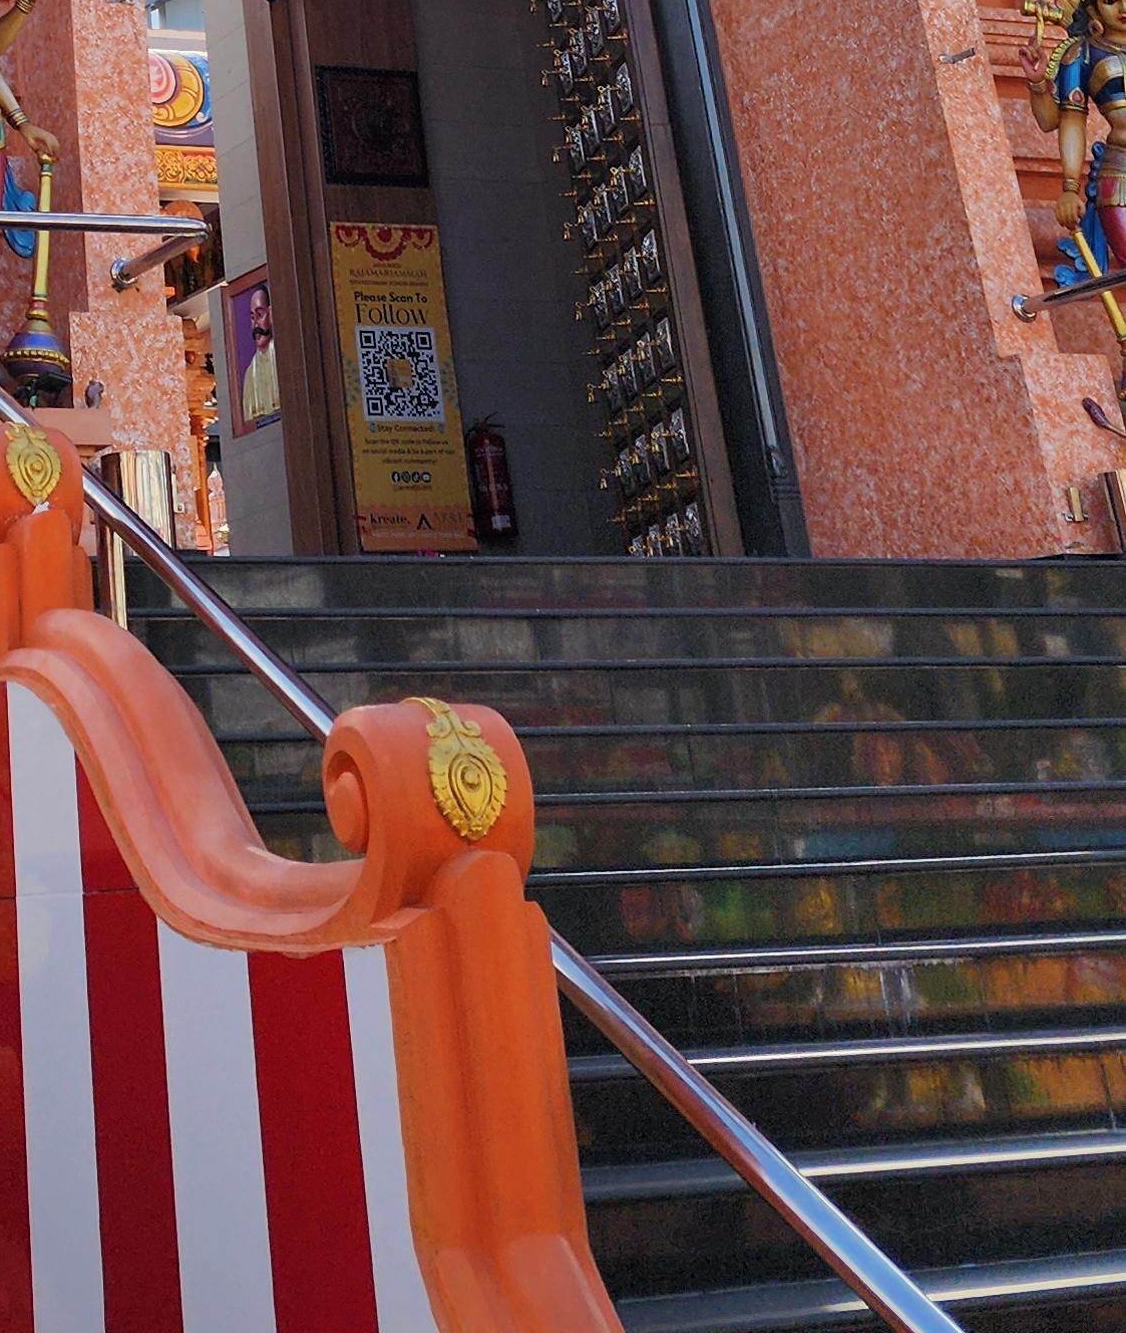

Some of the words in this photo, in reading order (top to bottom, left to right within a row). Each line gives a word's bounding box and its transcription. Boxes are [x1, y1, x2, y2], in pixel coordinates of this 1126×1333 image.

[354, 291, 387, 302] Please
[389, 291, 413, 303] Scan
[415, 293, 428, 303] To
[355, 303, 428, 325] Follow
